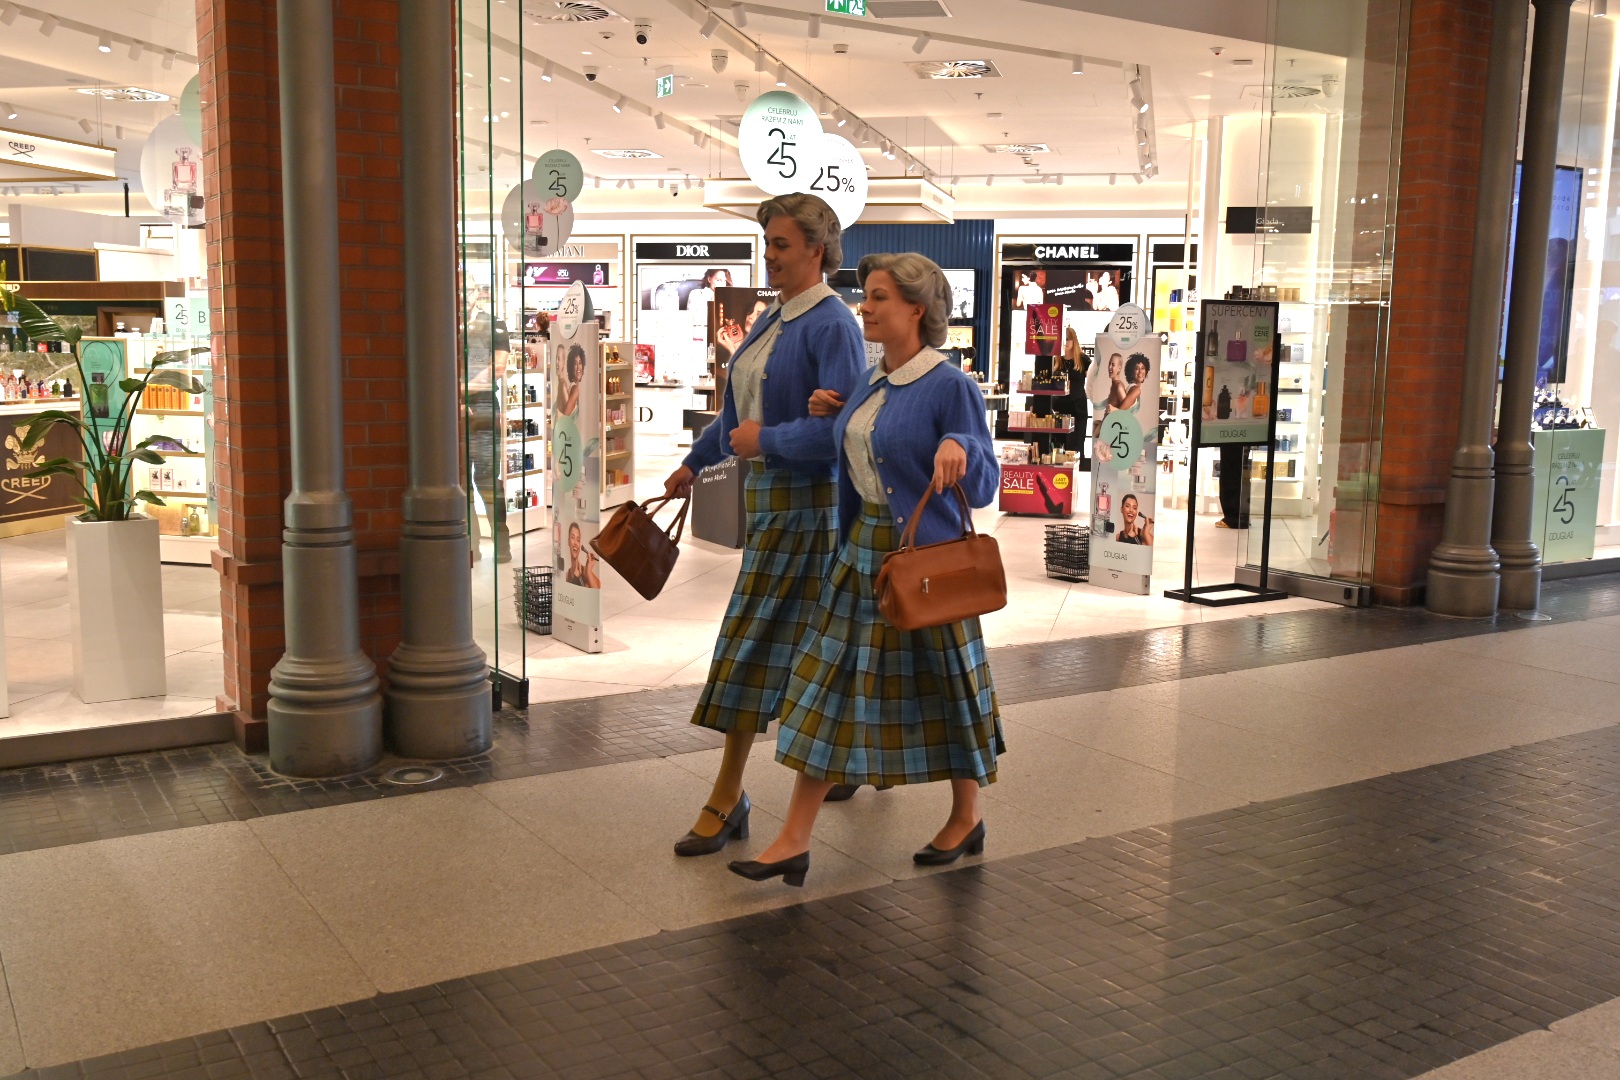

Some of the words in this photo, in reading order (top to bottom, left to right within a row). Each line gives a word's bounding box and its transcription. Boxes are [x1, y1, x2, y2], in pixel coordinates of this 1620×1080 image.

[8, 141, 35, 153] CREED
[767, 128, 796, 178] 25
[549, 170, 567, 197] 25
[810, 166, 855, 192] 25%
[676, 245, 710, 257] DIOR
[1034, 246, 1099, 259] CHANEL
[564, 298, 579, 314] -25%
[1212, 305, 1269, 317] SUPERCENY
[176, 304, 188, 325] 25
[1116, 317, 1138, 329] -25%
[1030, 325, 1058, 335] SALE
[876, 343, 885, 353] LA
[1110, 422, 1129, 458] 25
[1220, 430, 1247, 438] DOUGLAS
[559, 431, 572, 477] 25
[1, 476, 51, 496] CREED
[1003, 478, 1034, 489] SALE
[1553, 476, 1576, 524] 25
[1549, 531, 1573, 541] DOUGLAS
[1104, 551, 1127, 560] DOUGLAS
